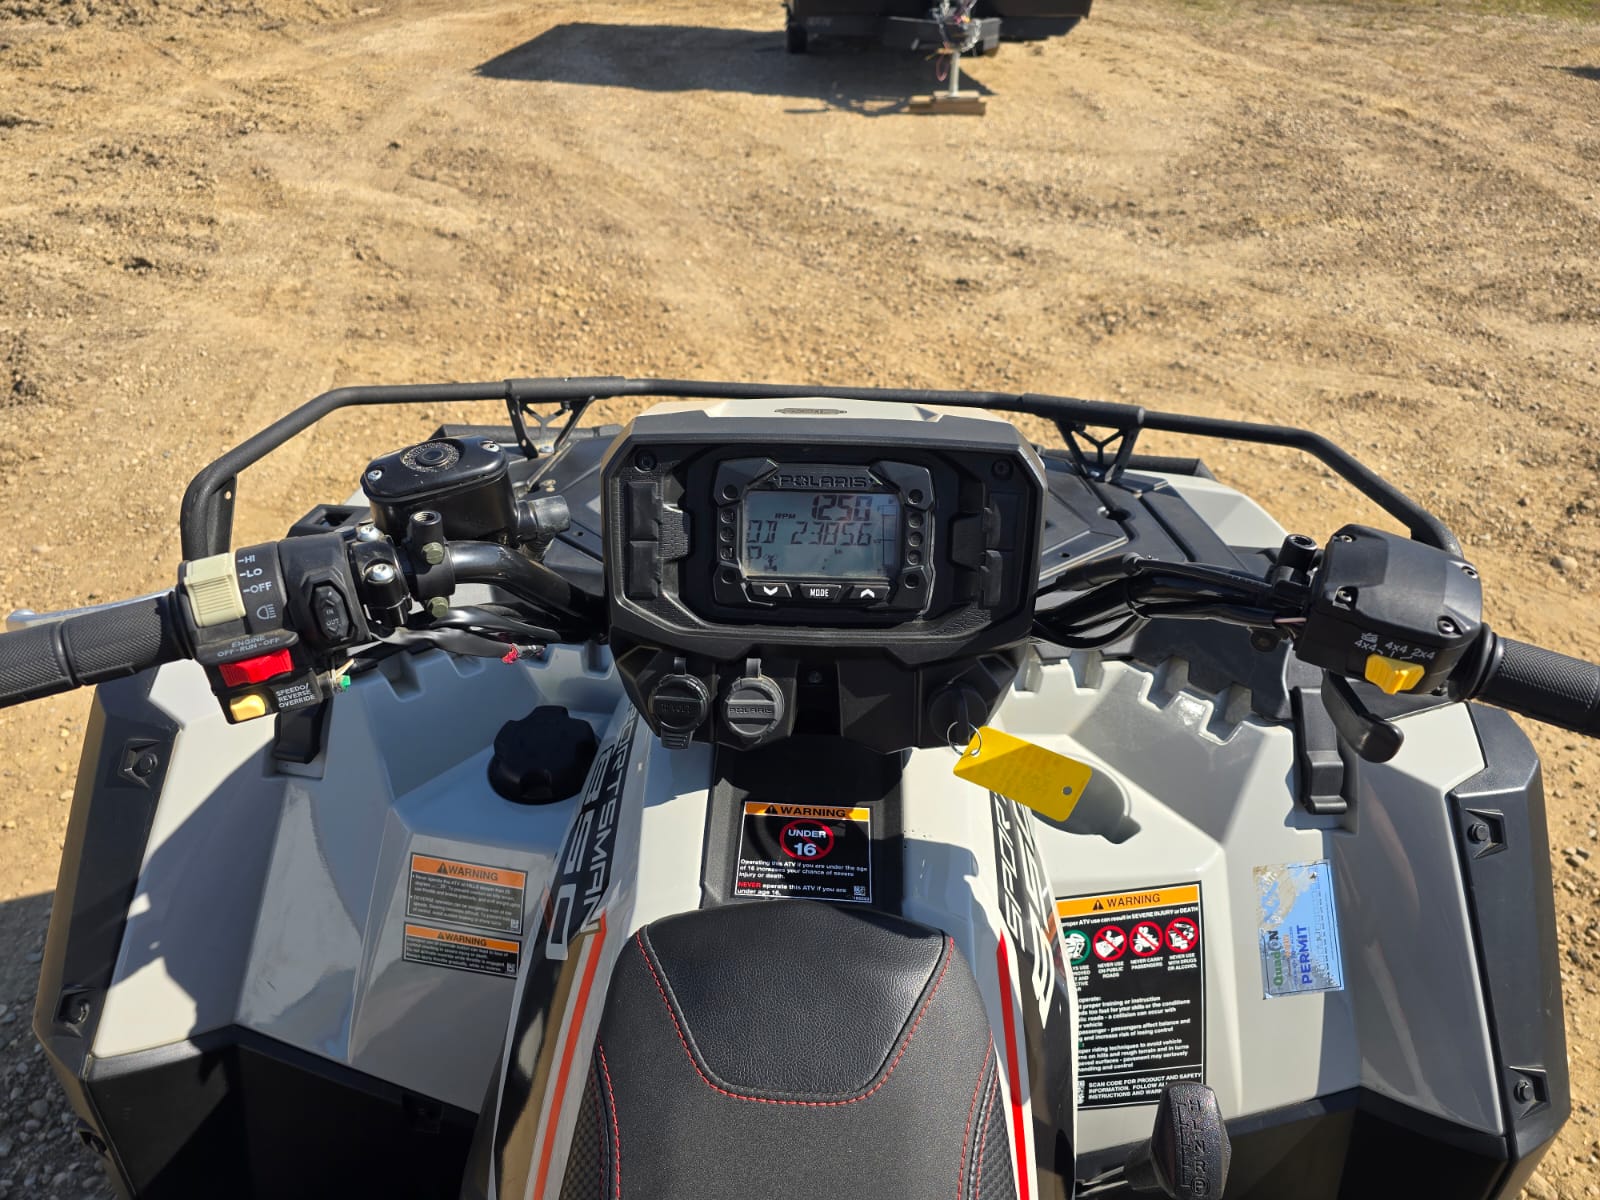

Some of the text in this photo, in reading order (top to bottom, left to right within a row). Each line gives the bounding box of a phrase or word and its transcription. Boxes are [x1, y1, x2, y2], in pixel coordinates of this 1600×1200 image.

[779, 475, 867, 488] POLARIS
[812, 494, 872, 521] 1250
[250, 582, 272, 594] OFF
[810, 588, 829, 598] MODE
[326, 618, 340, 626] OUT
[232, 636, 266, 648] ENGINE
[278, 689, 312, 702] REVERSE
[278, 694, 316, 708] OVERRIDE
[780, 806, 845, 817] WARNING
[787, 829, 826, 838] UNDER
[793, 842, 816, 856] 16
[448, 866, 498, 880] WARNING
[1107, 893, 1160, 908] WARNING
[444, 933, 487, 946] WARNING
[1296, 925, 1312, 985] PERMIT
[1137, 1074, 1164, 1083] PRODUCT
[1132, 1081, 1156, 1090] FOLLOW
